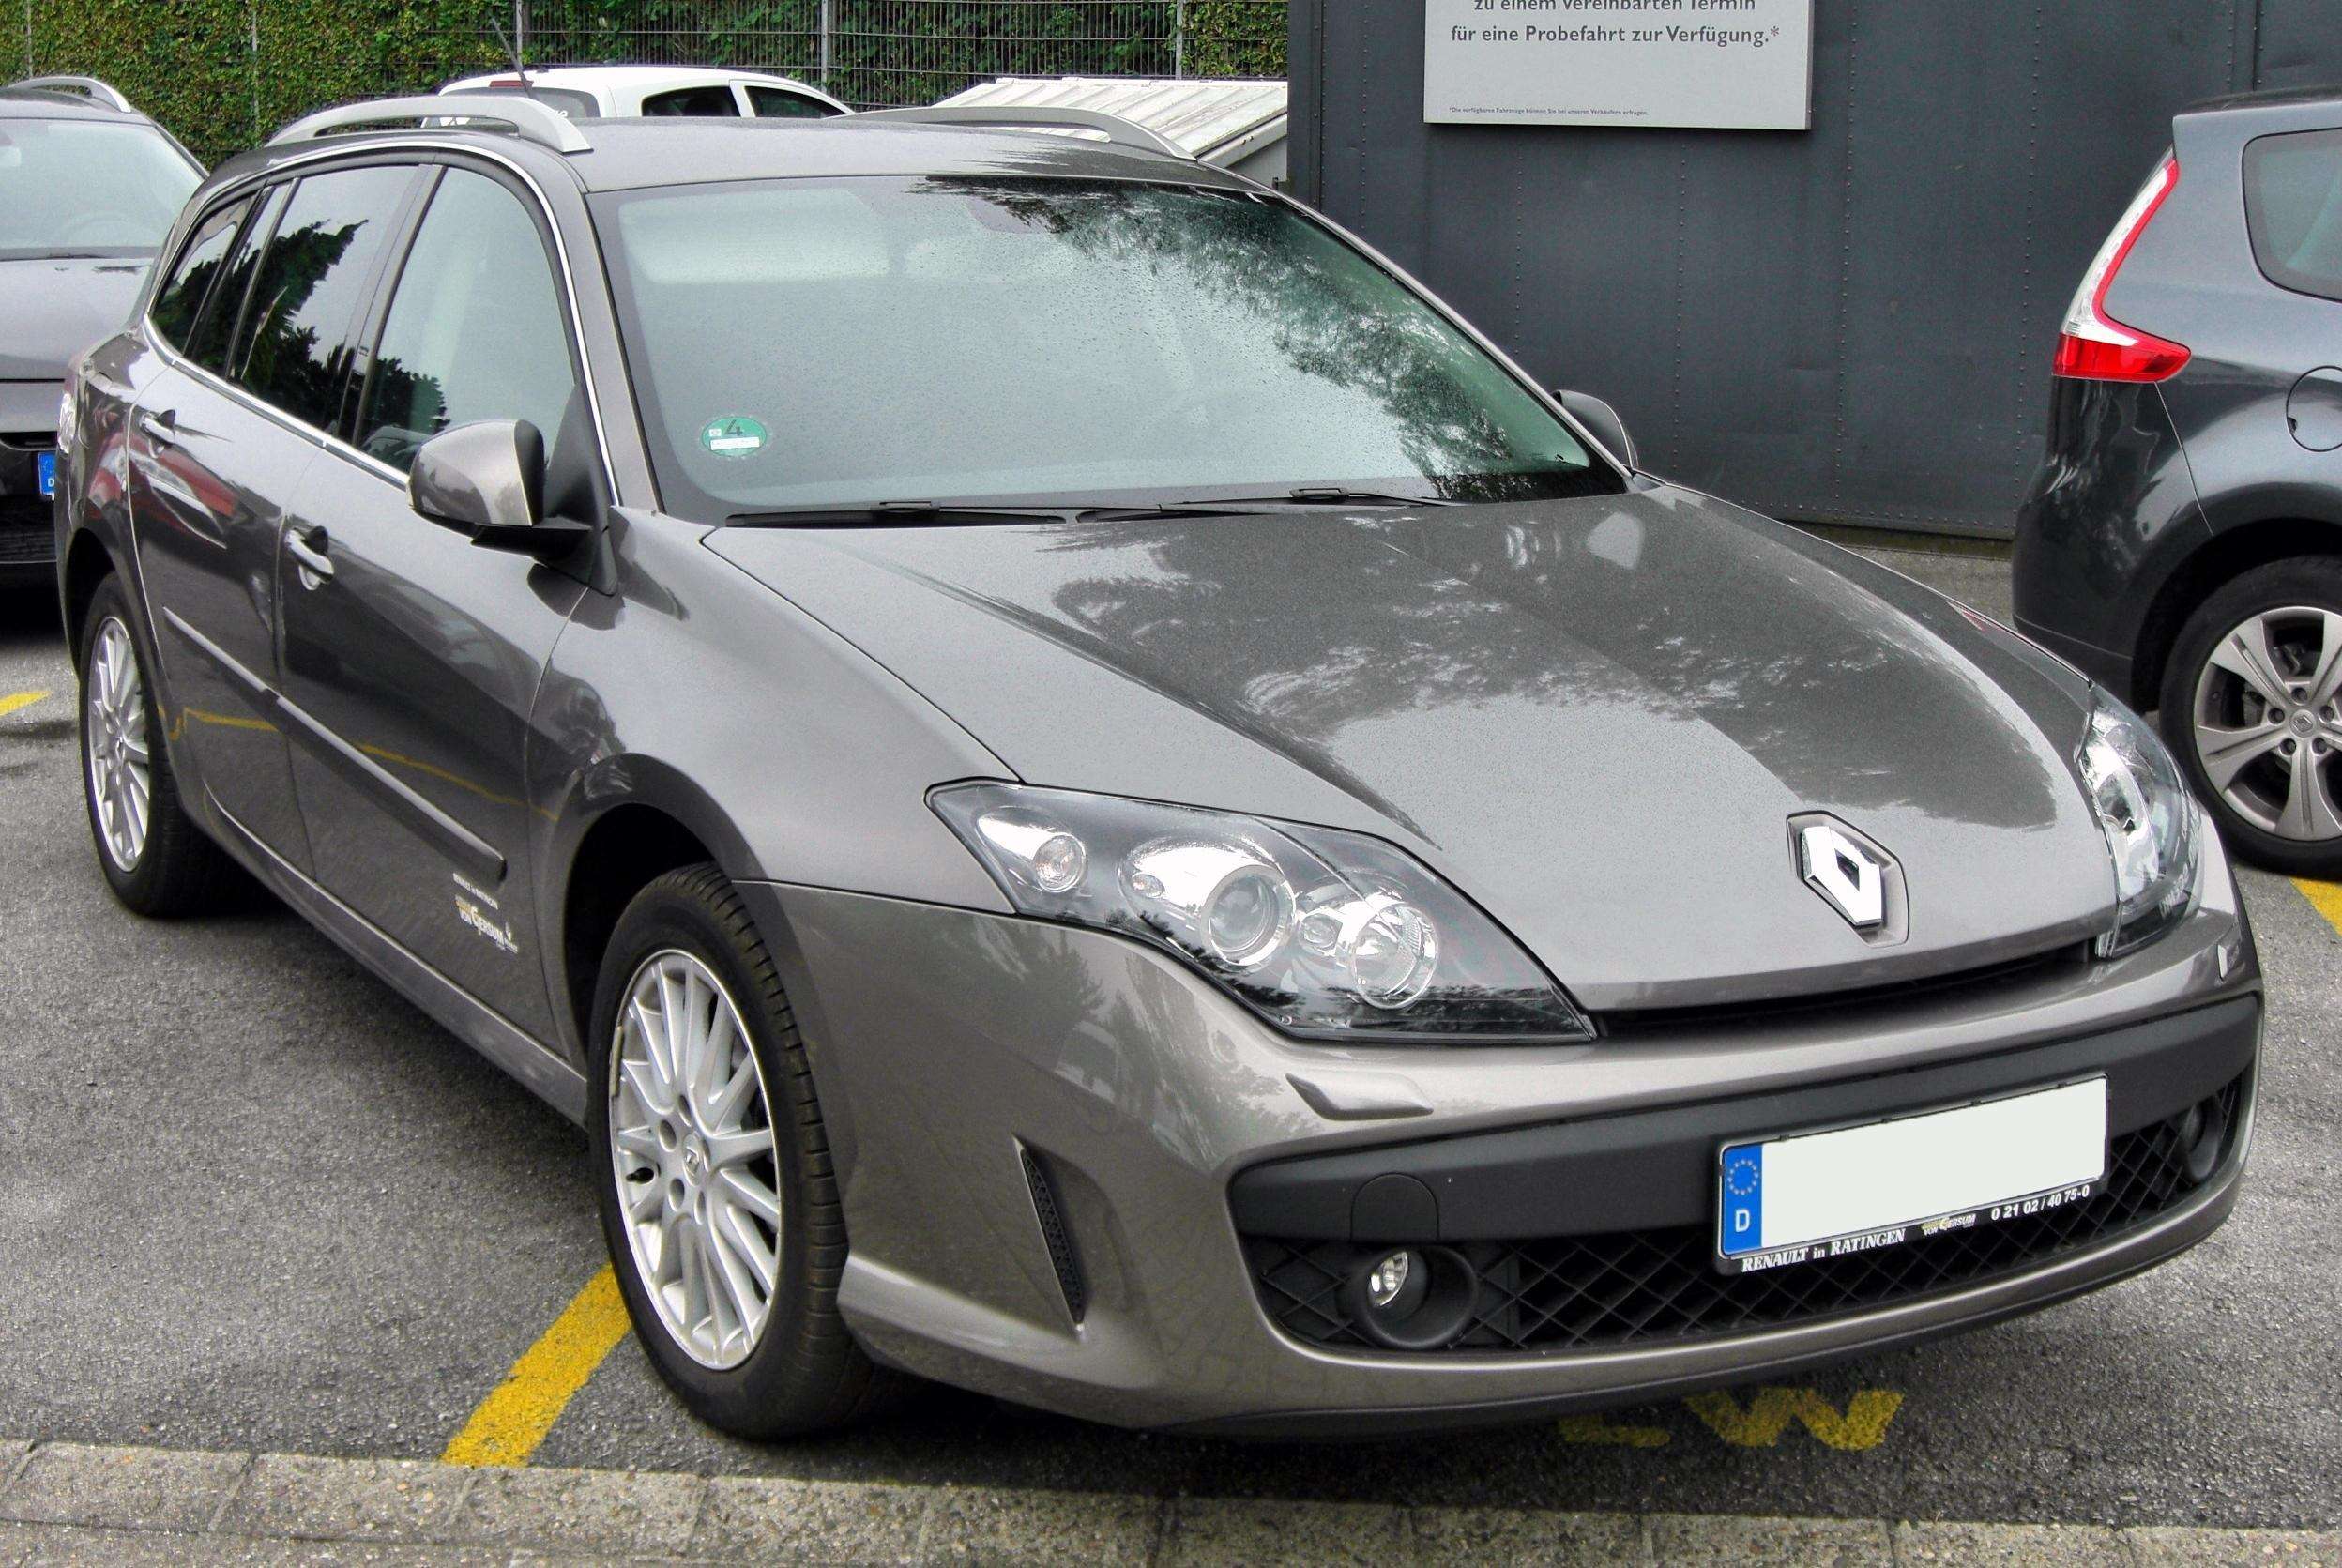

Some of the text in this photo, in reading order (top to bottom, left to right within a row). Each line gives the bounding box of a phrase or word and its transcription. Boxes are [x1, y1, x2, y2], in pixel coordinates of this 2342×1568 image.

[1474, 0, 1495, 10] zu
[1501, 0, 1556, 10] einem
[1563, 0, 1683, 10] vereinbarten
[1452, 25, 1476, 41] für
[1483, 26, 1518, 41] eine
[1526, 25, 1625, 41] Probefahrt
[1632, 30, 1663, 41] zur
[724, 419, 743, 436] 4
[1736, 1209, 1751, 1232] D
[1741, 1247, 1809, 1272] RENAULT
[1813, 1248, 1826, 1259] in
[1831, 1228, 1907, 1256] RATINGEN
[2063, 1184, 2091, 1203] 75-0
